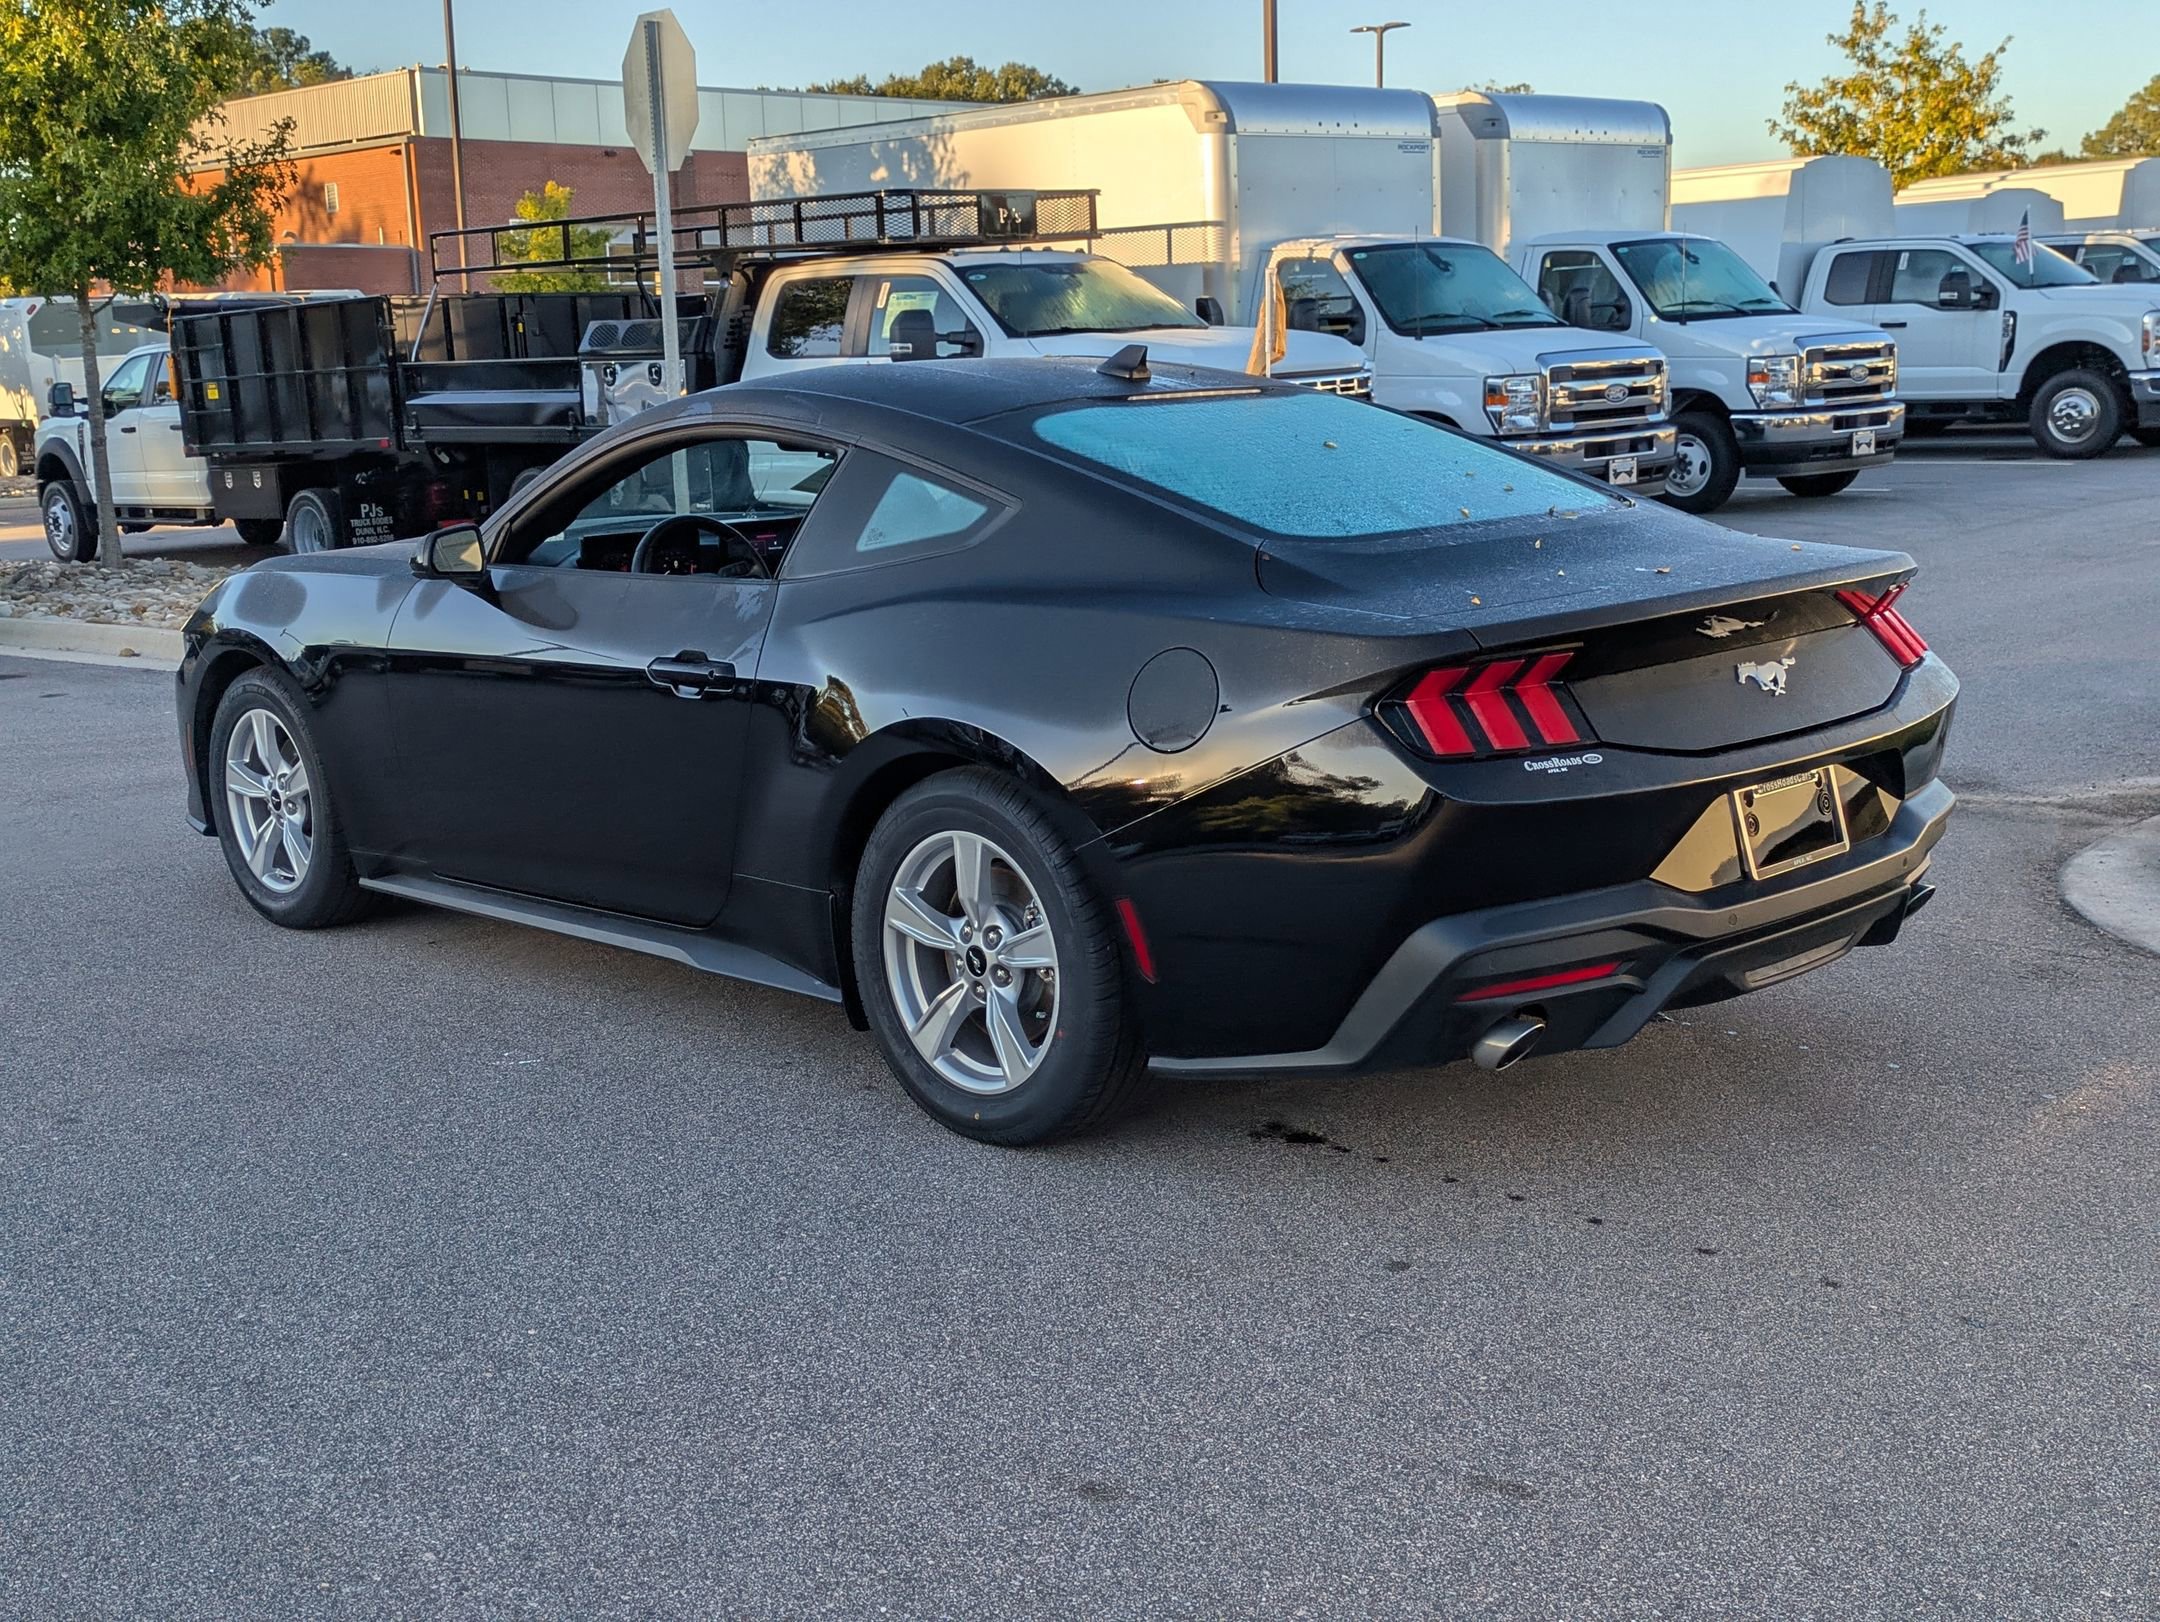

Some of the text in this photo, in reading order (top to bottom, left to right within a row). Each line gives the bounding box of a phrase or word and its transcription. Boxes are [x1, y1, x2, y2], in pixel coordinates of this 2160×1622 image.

[360, 503, 384, 517] PJs
[350, 516, 393, 527] TRUCK BODIES
